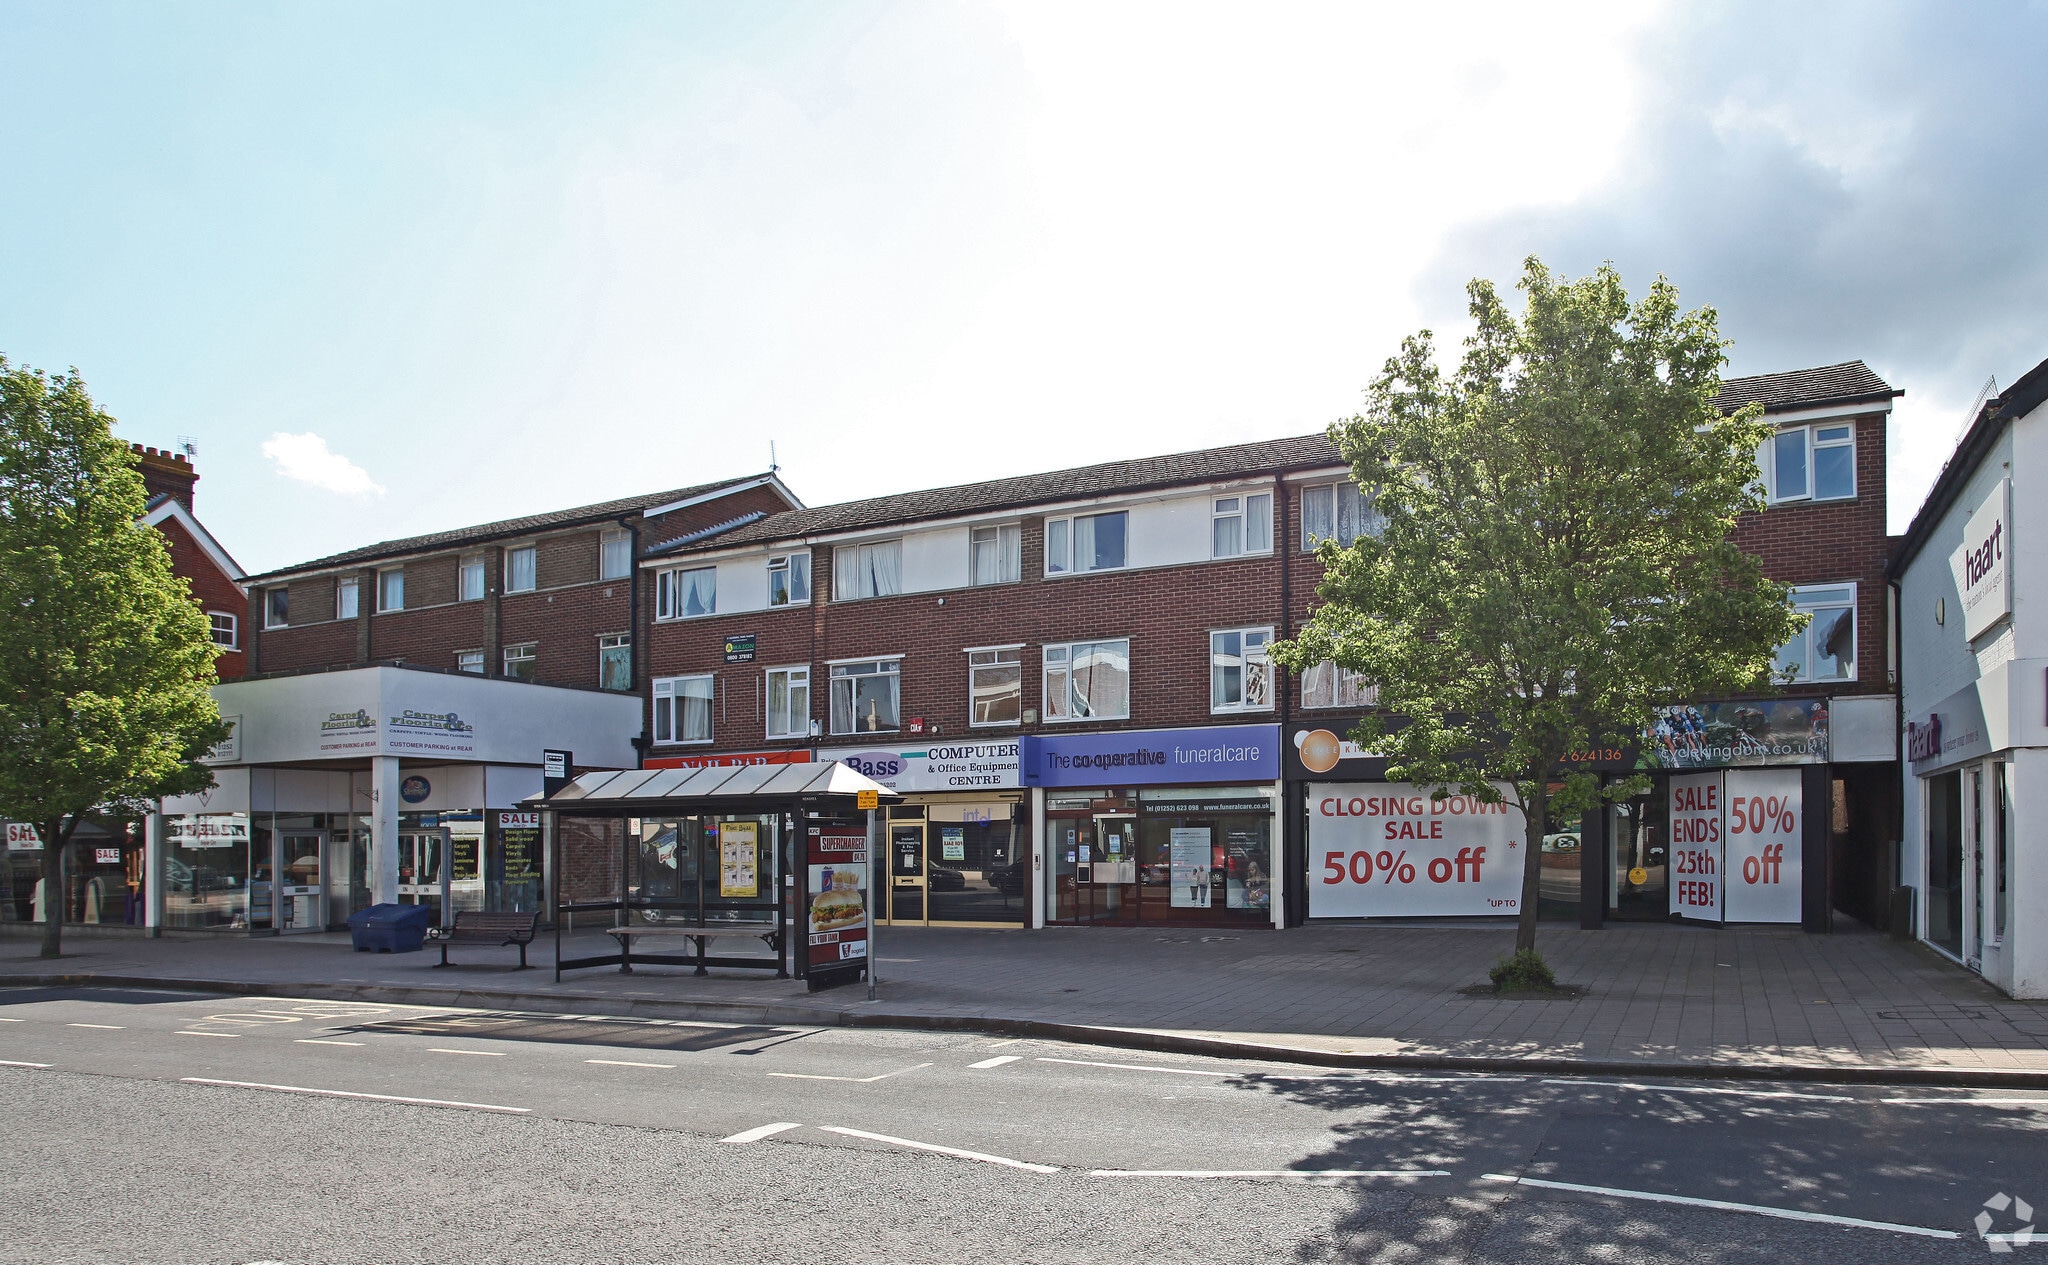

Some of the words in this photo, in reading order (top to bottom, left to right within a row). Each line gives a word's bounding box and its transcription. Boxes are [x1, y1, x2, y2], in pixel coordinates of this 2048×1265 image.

[1966, 519, 2001, 591] haart
[1908, 714, 1941, 762] haart
[928, 744, 1019, 760] COMPUTER
[1047, 753, 1070, 769] The
[1175, 744, 1260, 764] funeralcare
[1571, 749, 1622, 762] 624136
[1661, 742, 1815, 763] cyclekingdom.co.uk
[846, 757, 898, 776] Bass
[928, 764, 936, 773] &
[938, 763, 966, 773] Office
[970, 762, 1019, 773] Equipmen
[949, 775, 1001, 786] CENTRE
[1203, 803, 1270, 811] www.funeralcare.co.uk
[1320, 797, 1423, 817] CLOSING
[1430, 796, 1507, 816] DOWN
[1675, 785, 1717, 812] SALE
[501, 813, 538, 823] SALE
[963, 808, 991, 827] intel
[1154, 804, 1176, 813] (01252)
[1731, 796, 1795, 834] 50%
[1385, 821, 1443, 840] SALE
[1673, 817, 1719, 843] ENDS
[822, 837, 865, 850] SUPERCHARGER
[97, 849, 119, 859] SALE
[1677, 849, 1715, 875] 25th
[1323, 850, 1416, 885] 50%
[1428, 846, 1486, 884] off
[1743, 843, 1784, 885] off
[1678, 880, 1714, 907] FEB!
[1504, 900, 1517, 908] TO
